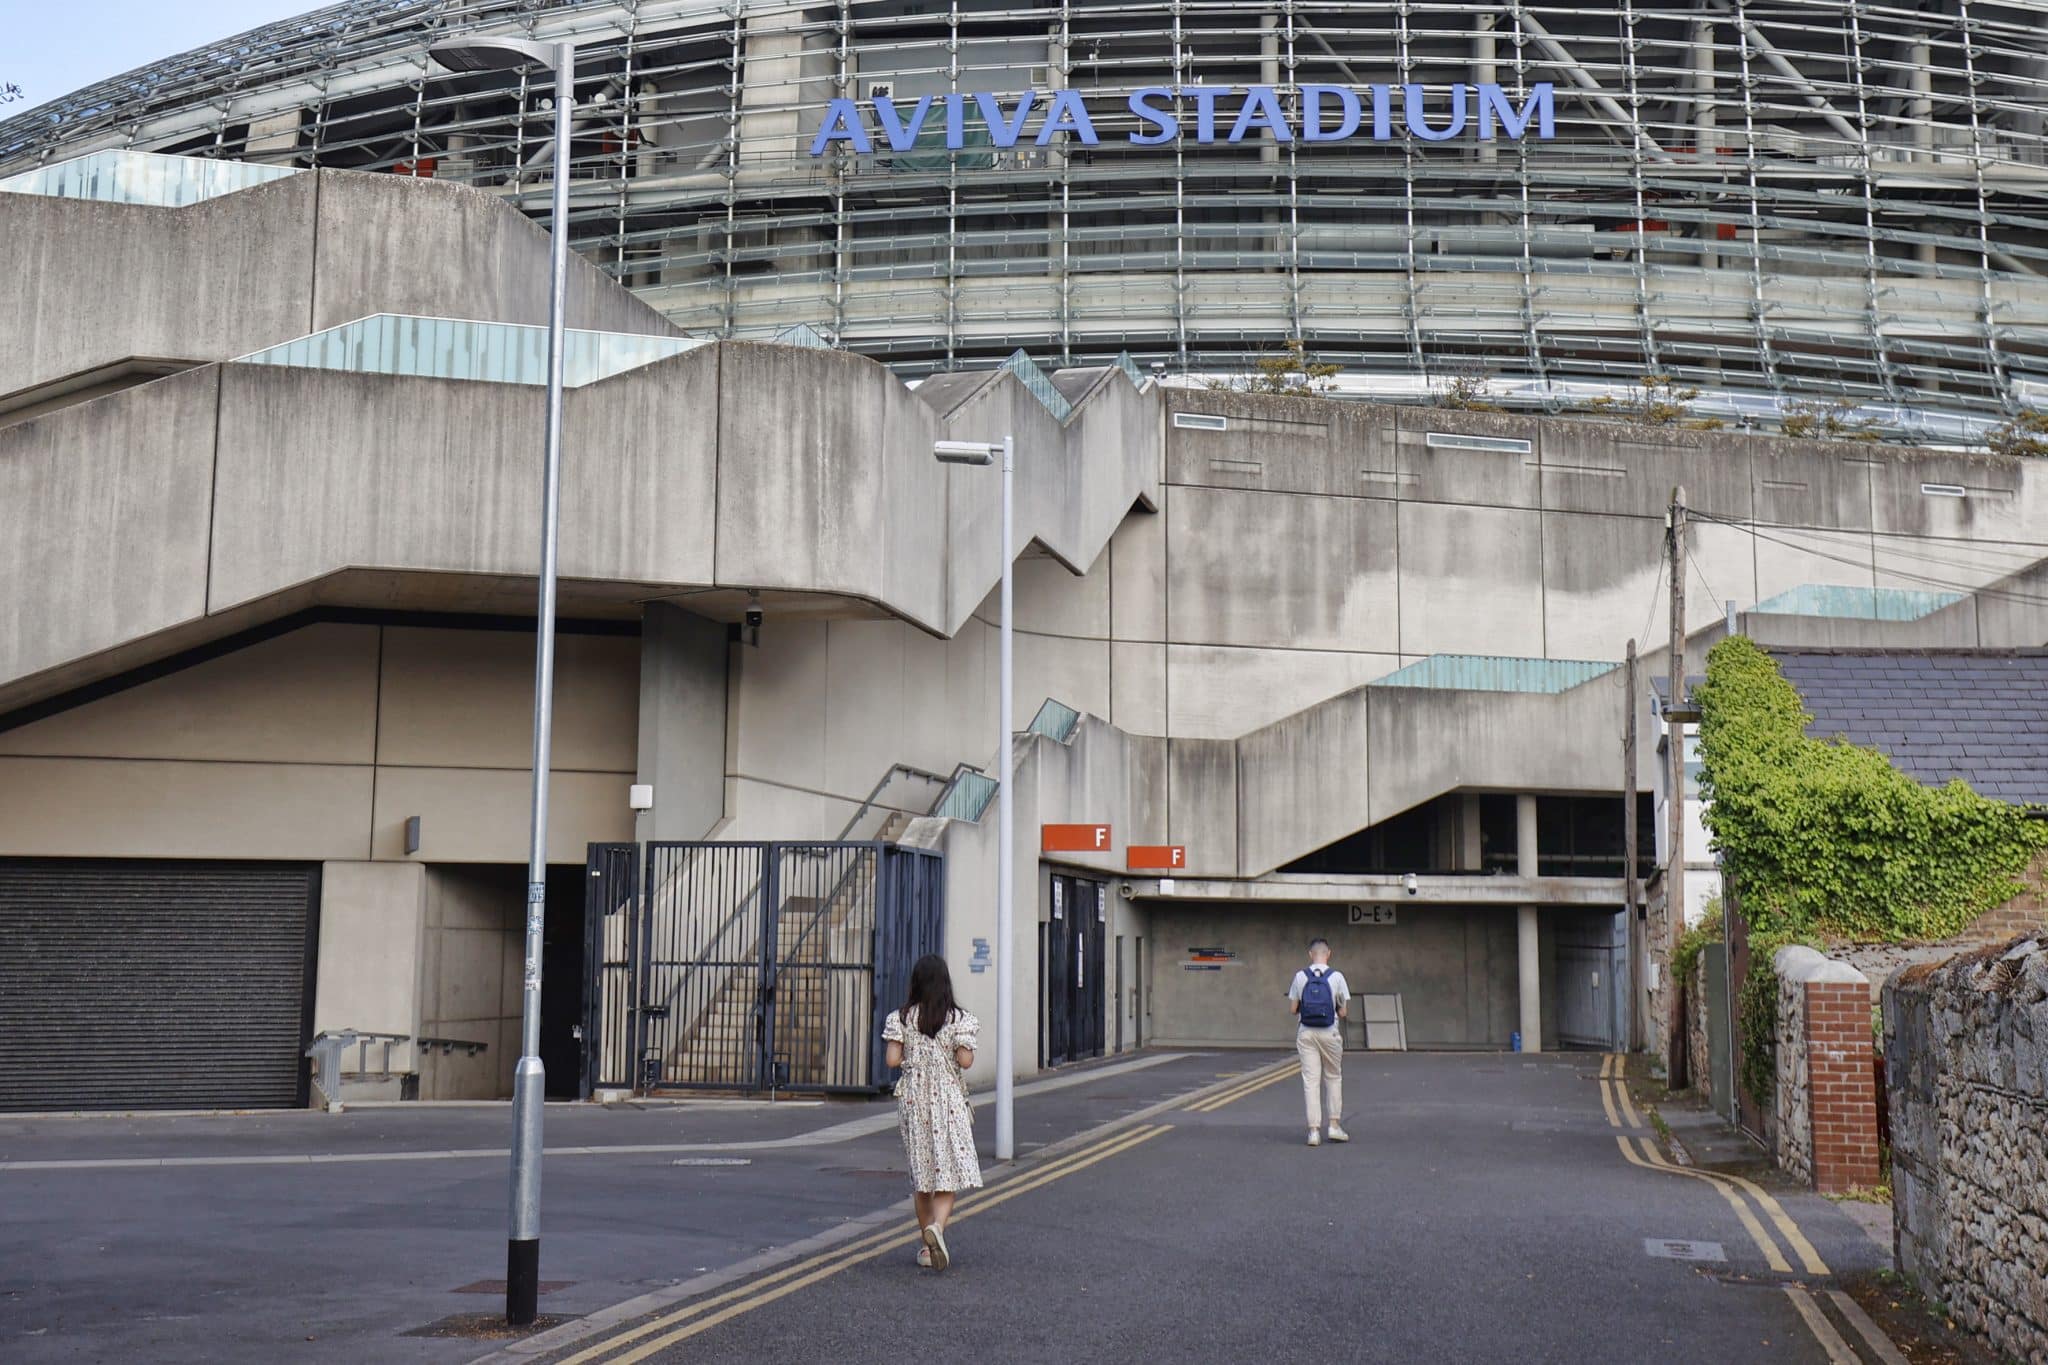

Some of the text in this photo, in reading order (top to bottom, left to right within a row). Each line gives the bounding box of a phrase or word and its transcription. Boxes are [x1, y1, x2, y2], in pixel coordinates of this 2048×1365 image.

[811, 83, 1554, 156] AVIVA STADIUM
[1095, 828, 1107, 847] F
[1172, 849, 1182, 865] F
